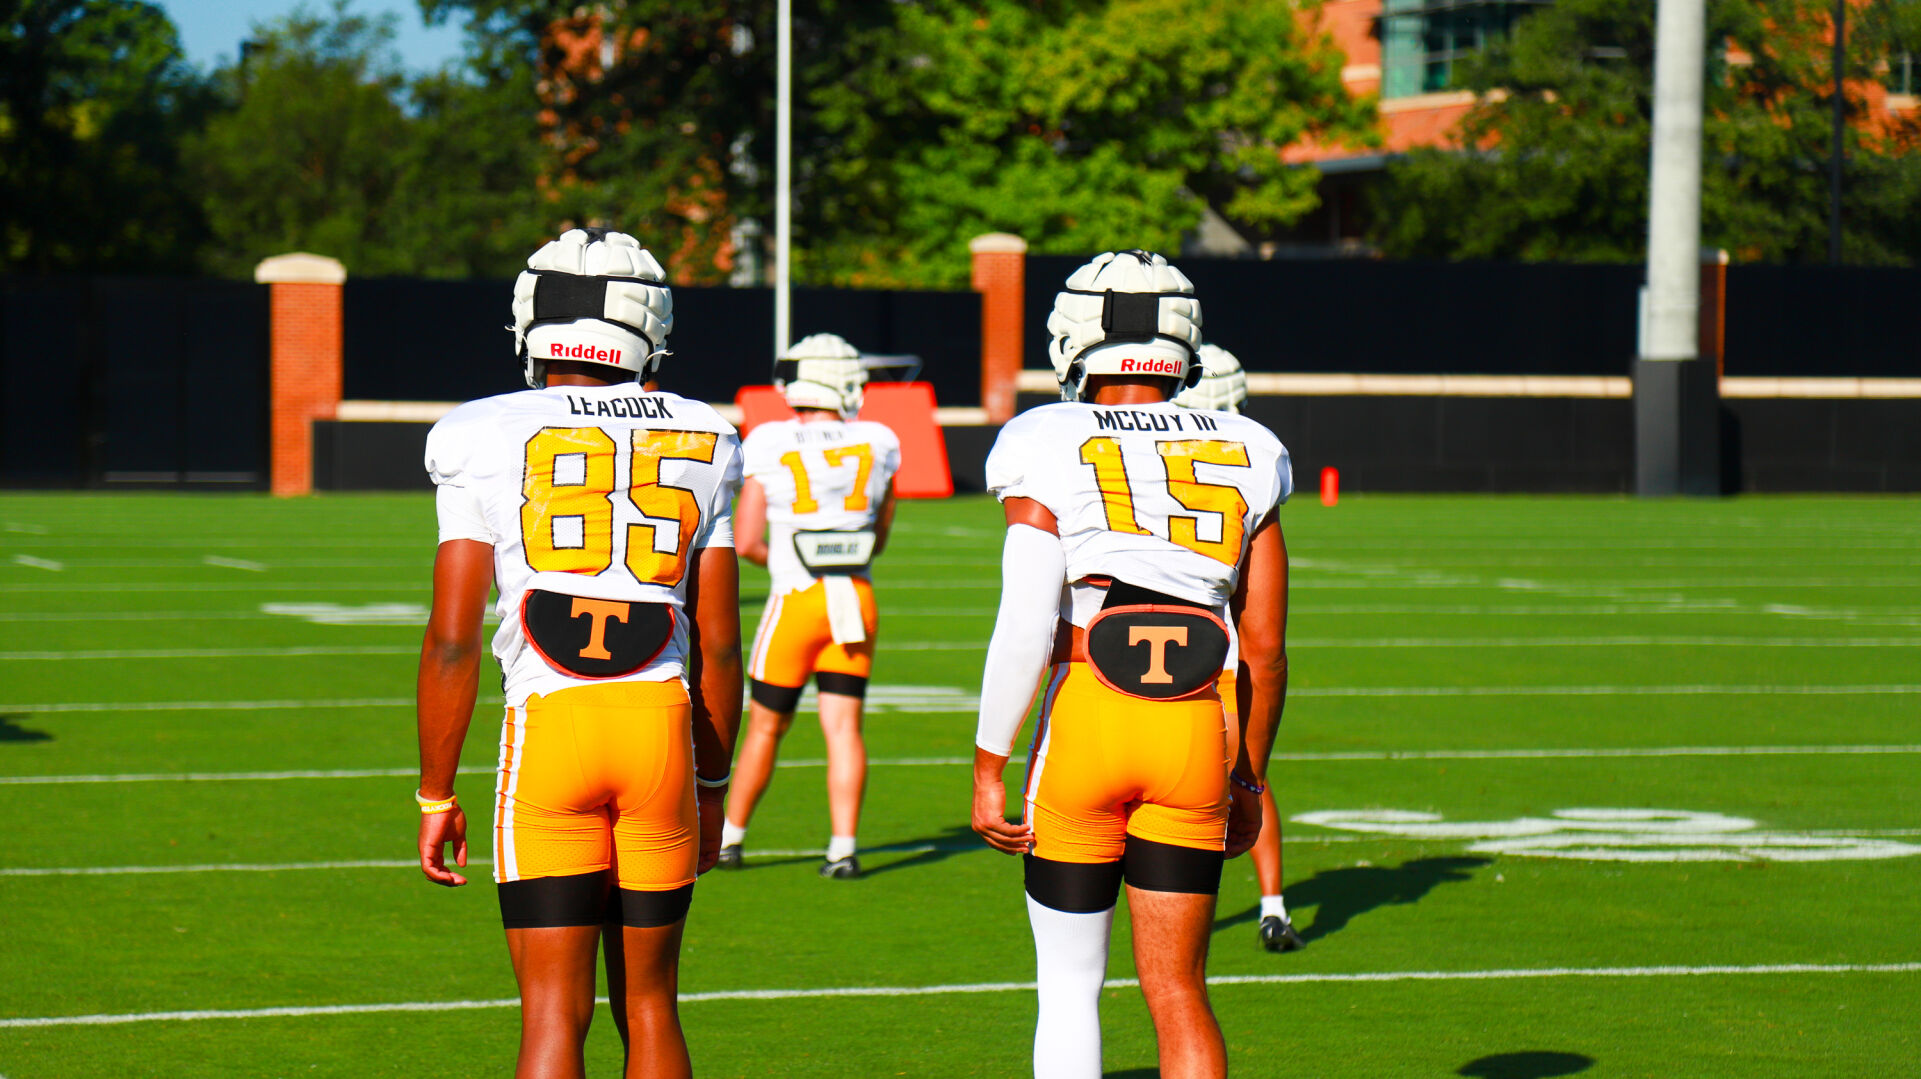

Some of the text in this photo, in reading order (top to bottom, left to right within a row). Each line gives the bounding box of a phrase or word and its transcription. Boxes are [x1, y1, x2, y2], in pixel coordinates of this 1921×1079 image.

[550, 343, 622, 365] Riddell
[1120, 358, 1182, 375] Riddell
[566, 394, 674, 419] LEACOCK
[519, 426, 719, 588] 85
[779, 443, 874, 514] 17
[1079, 435, 1252, 569] 15
[570, 596, 630, 661] T
[1128, 625, 1188, 684] T
